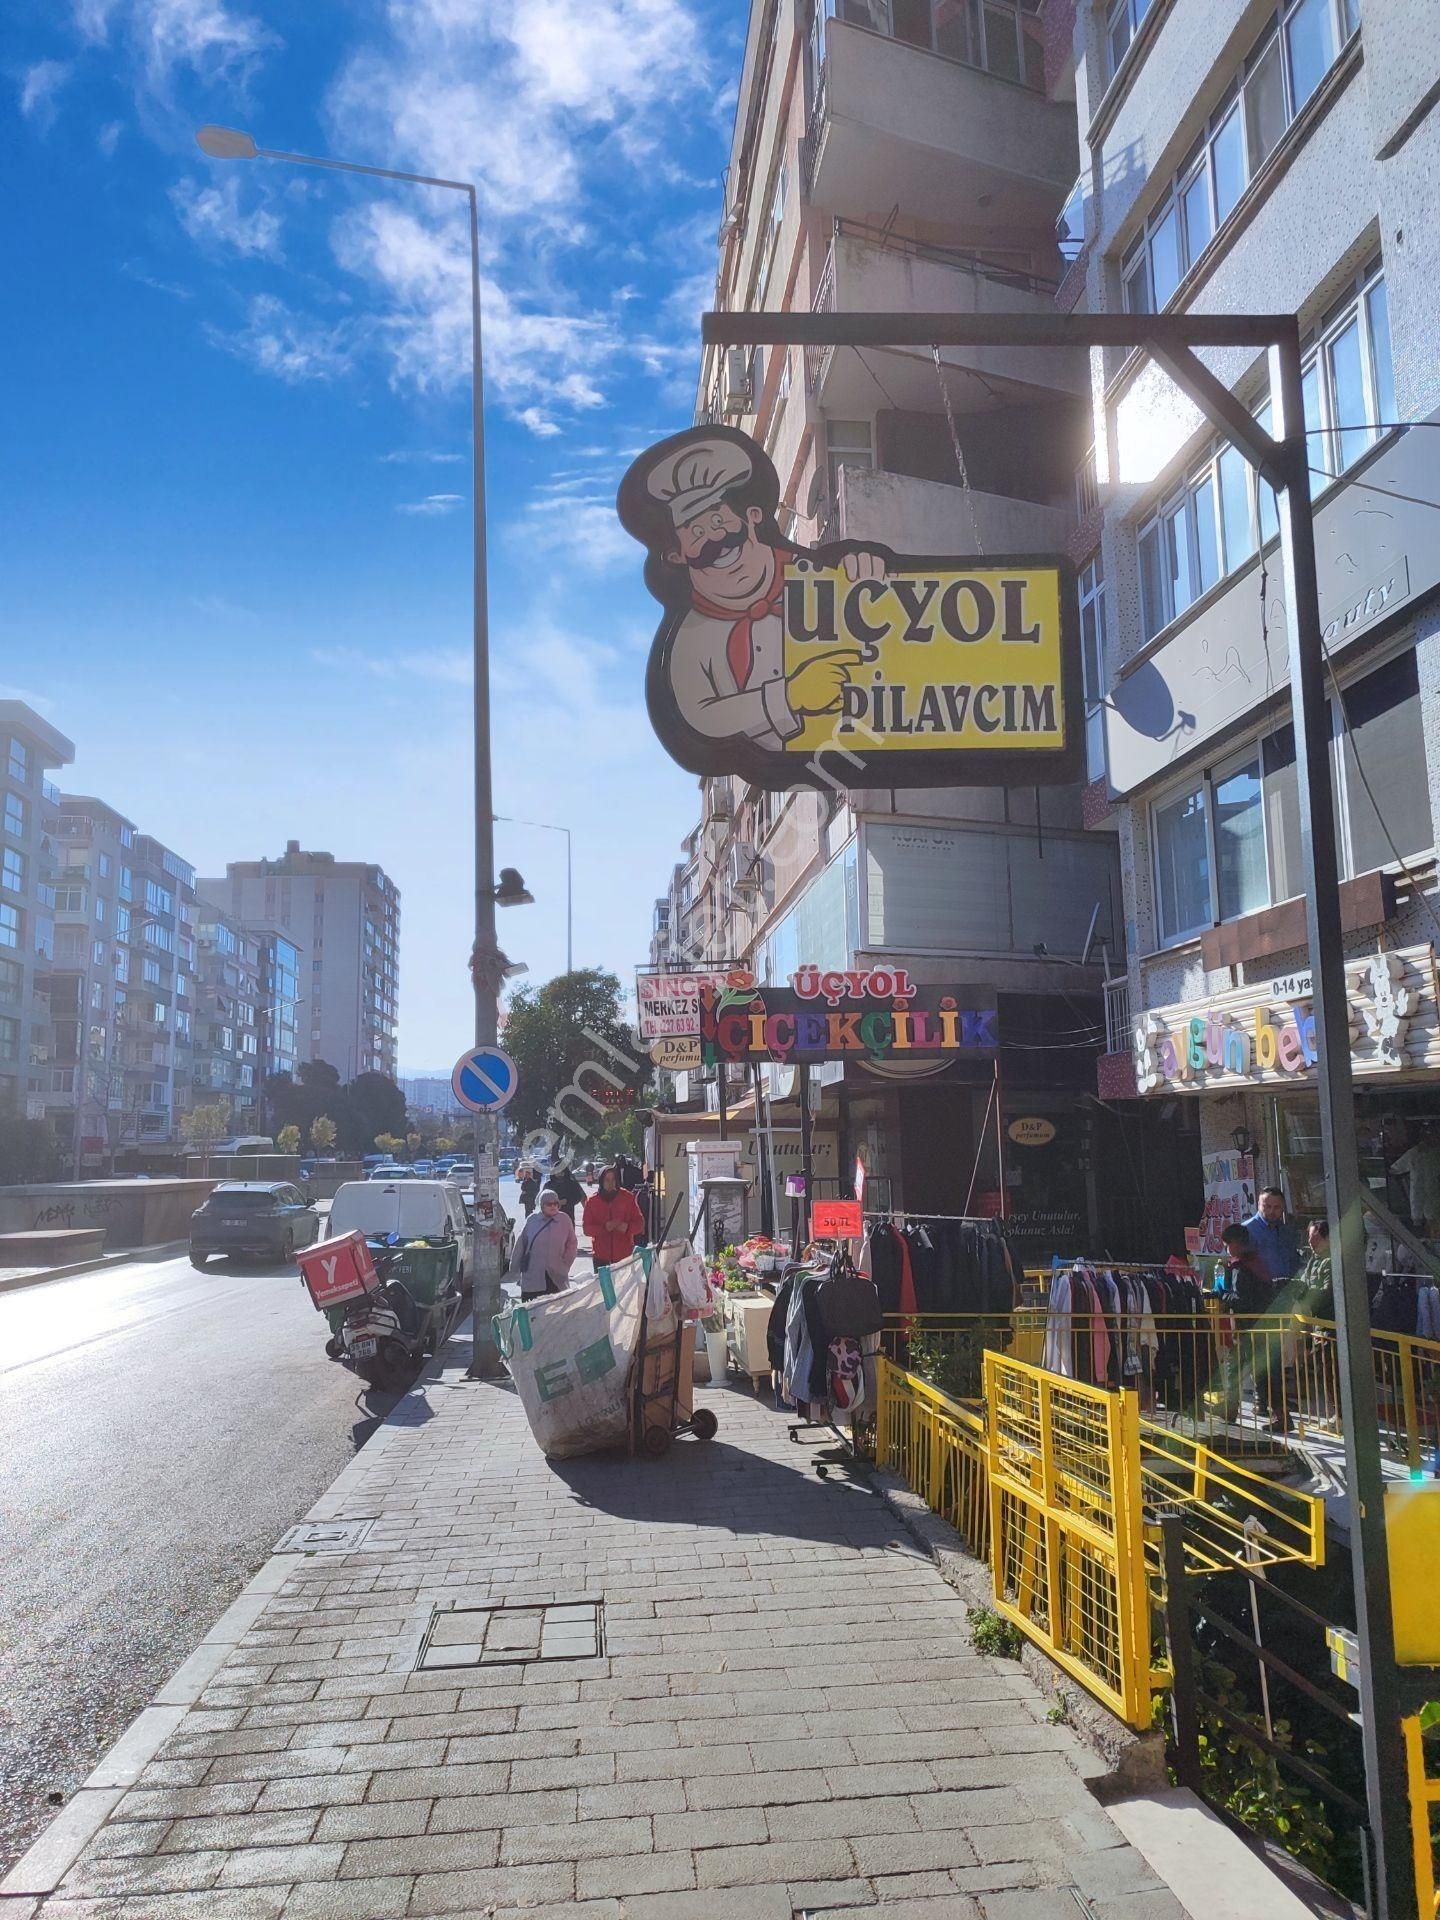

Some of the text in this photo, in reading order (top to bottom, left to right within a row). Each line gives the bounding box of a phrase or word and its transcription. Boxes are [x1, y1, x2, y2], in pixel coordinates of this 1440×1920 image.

[784, 559, 1040, 662] ÜÇYOL
[1321, 577, 1396, 641] auty
[840, 670, 1058, 735] PİLAVCIM
[793, 964, 917, 1006] ÜÇYOL
[1272, 977, 1313, 996] 0-14 ya
[644, 999, 689, 1017] MERKEZ
[664, 1041, 698, 1054] D&P
[718, 996, 999, 1064] ÇİÇEKÇİLİK
[1255, 1004, 1318, 1072] beb
[659, 1053, 701, 1064] perfumu
[1021, 1122, 1042, 1131] D&P
